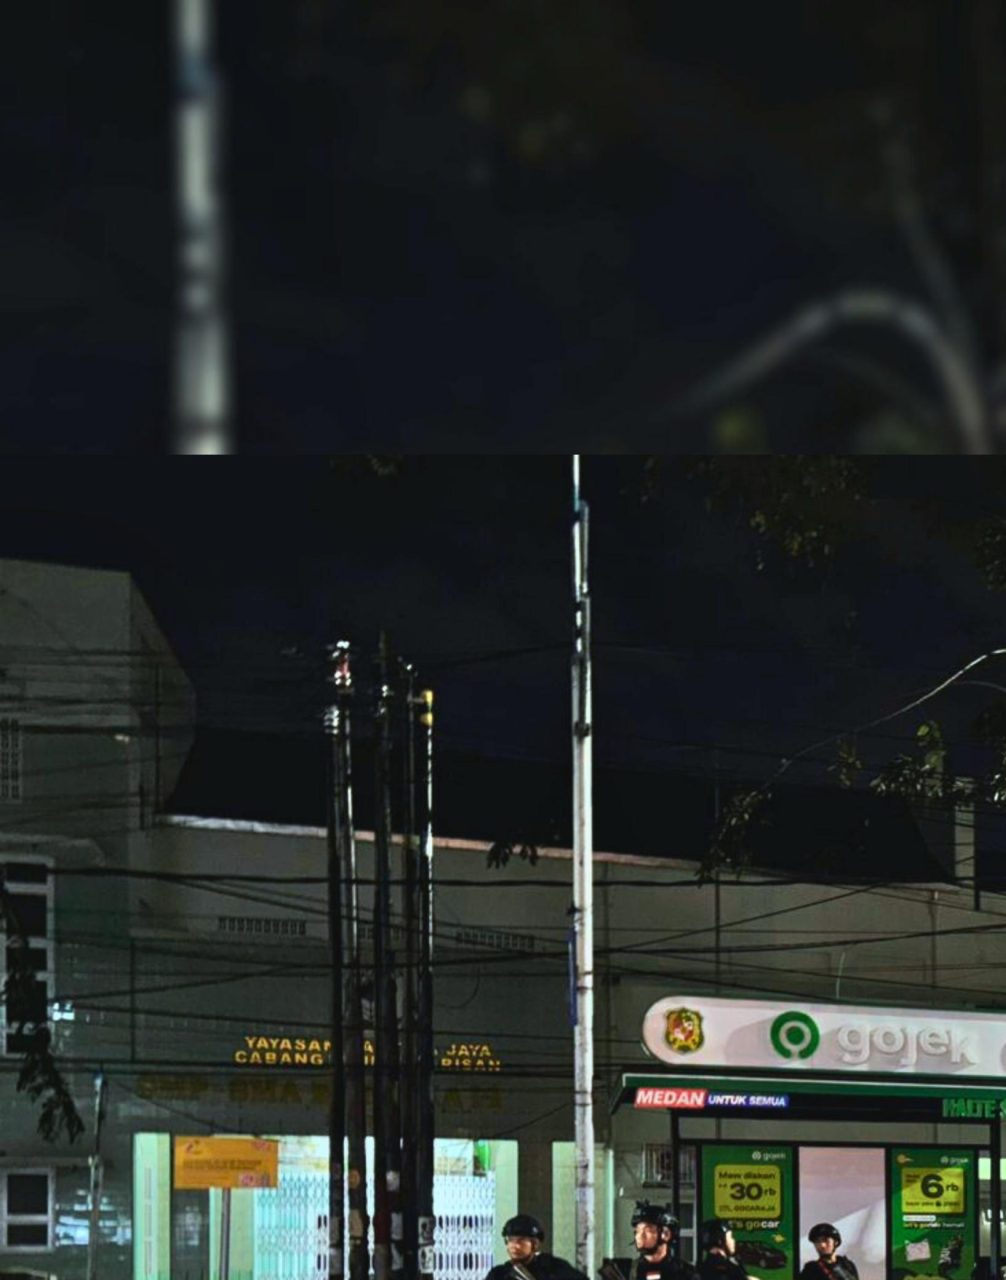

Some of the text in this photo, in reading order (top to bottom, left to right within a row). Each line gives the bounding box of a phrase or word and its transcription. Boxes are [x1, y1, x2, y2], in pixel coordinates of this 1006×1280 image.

[837, 1023, 977, 1066] gojek
[234, 1051, 324, 1066] CABANG
[635, 1089, 786, 1107] MEDAN UNTUK SEMUA
[730, 1182, 764, 1201] 30
[764, 1187, 777, 1196] rb
[921, 1173, 945, 1199] 6
[945, 1183, 960, 1192] rb
